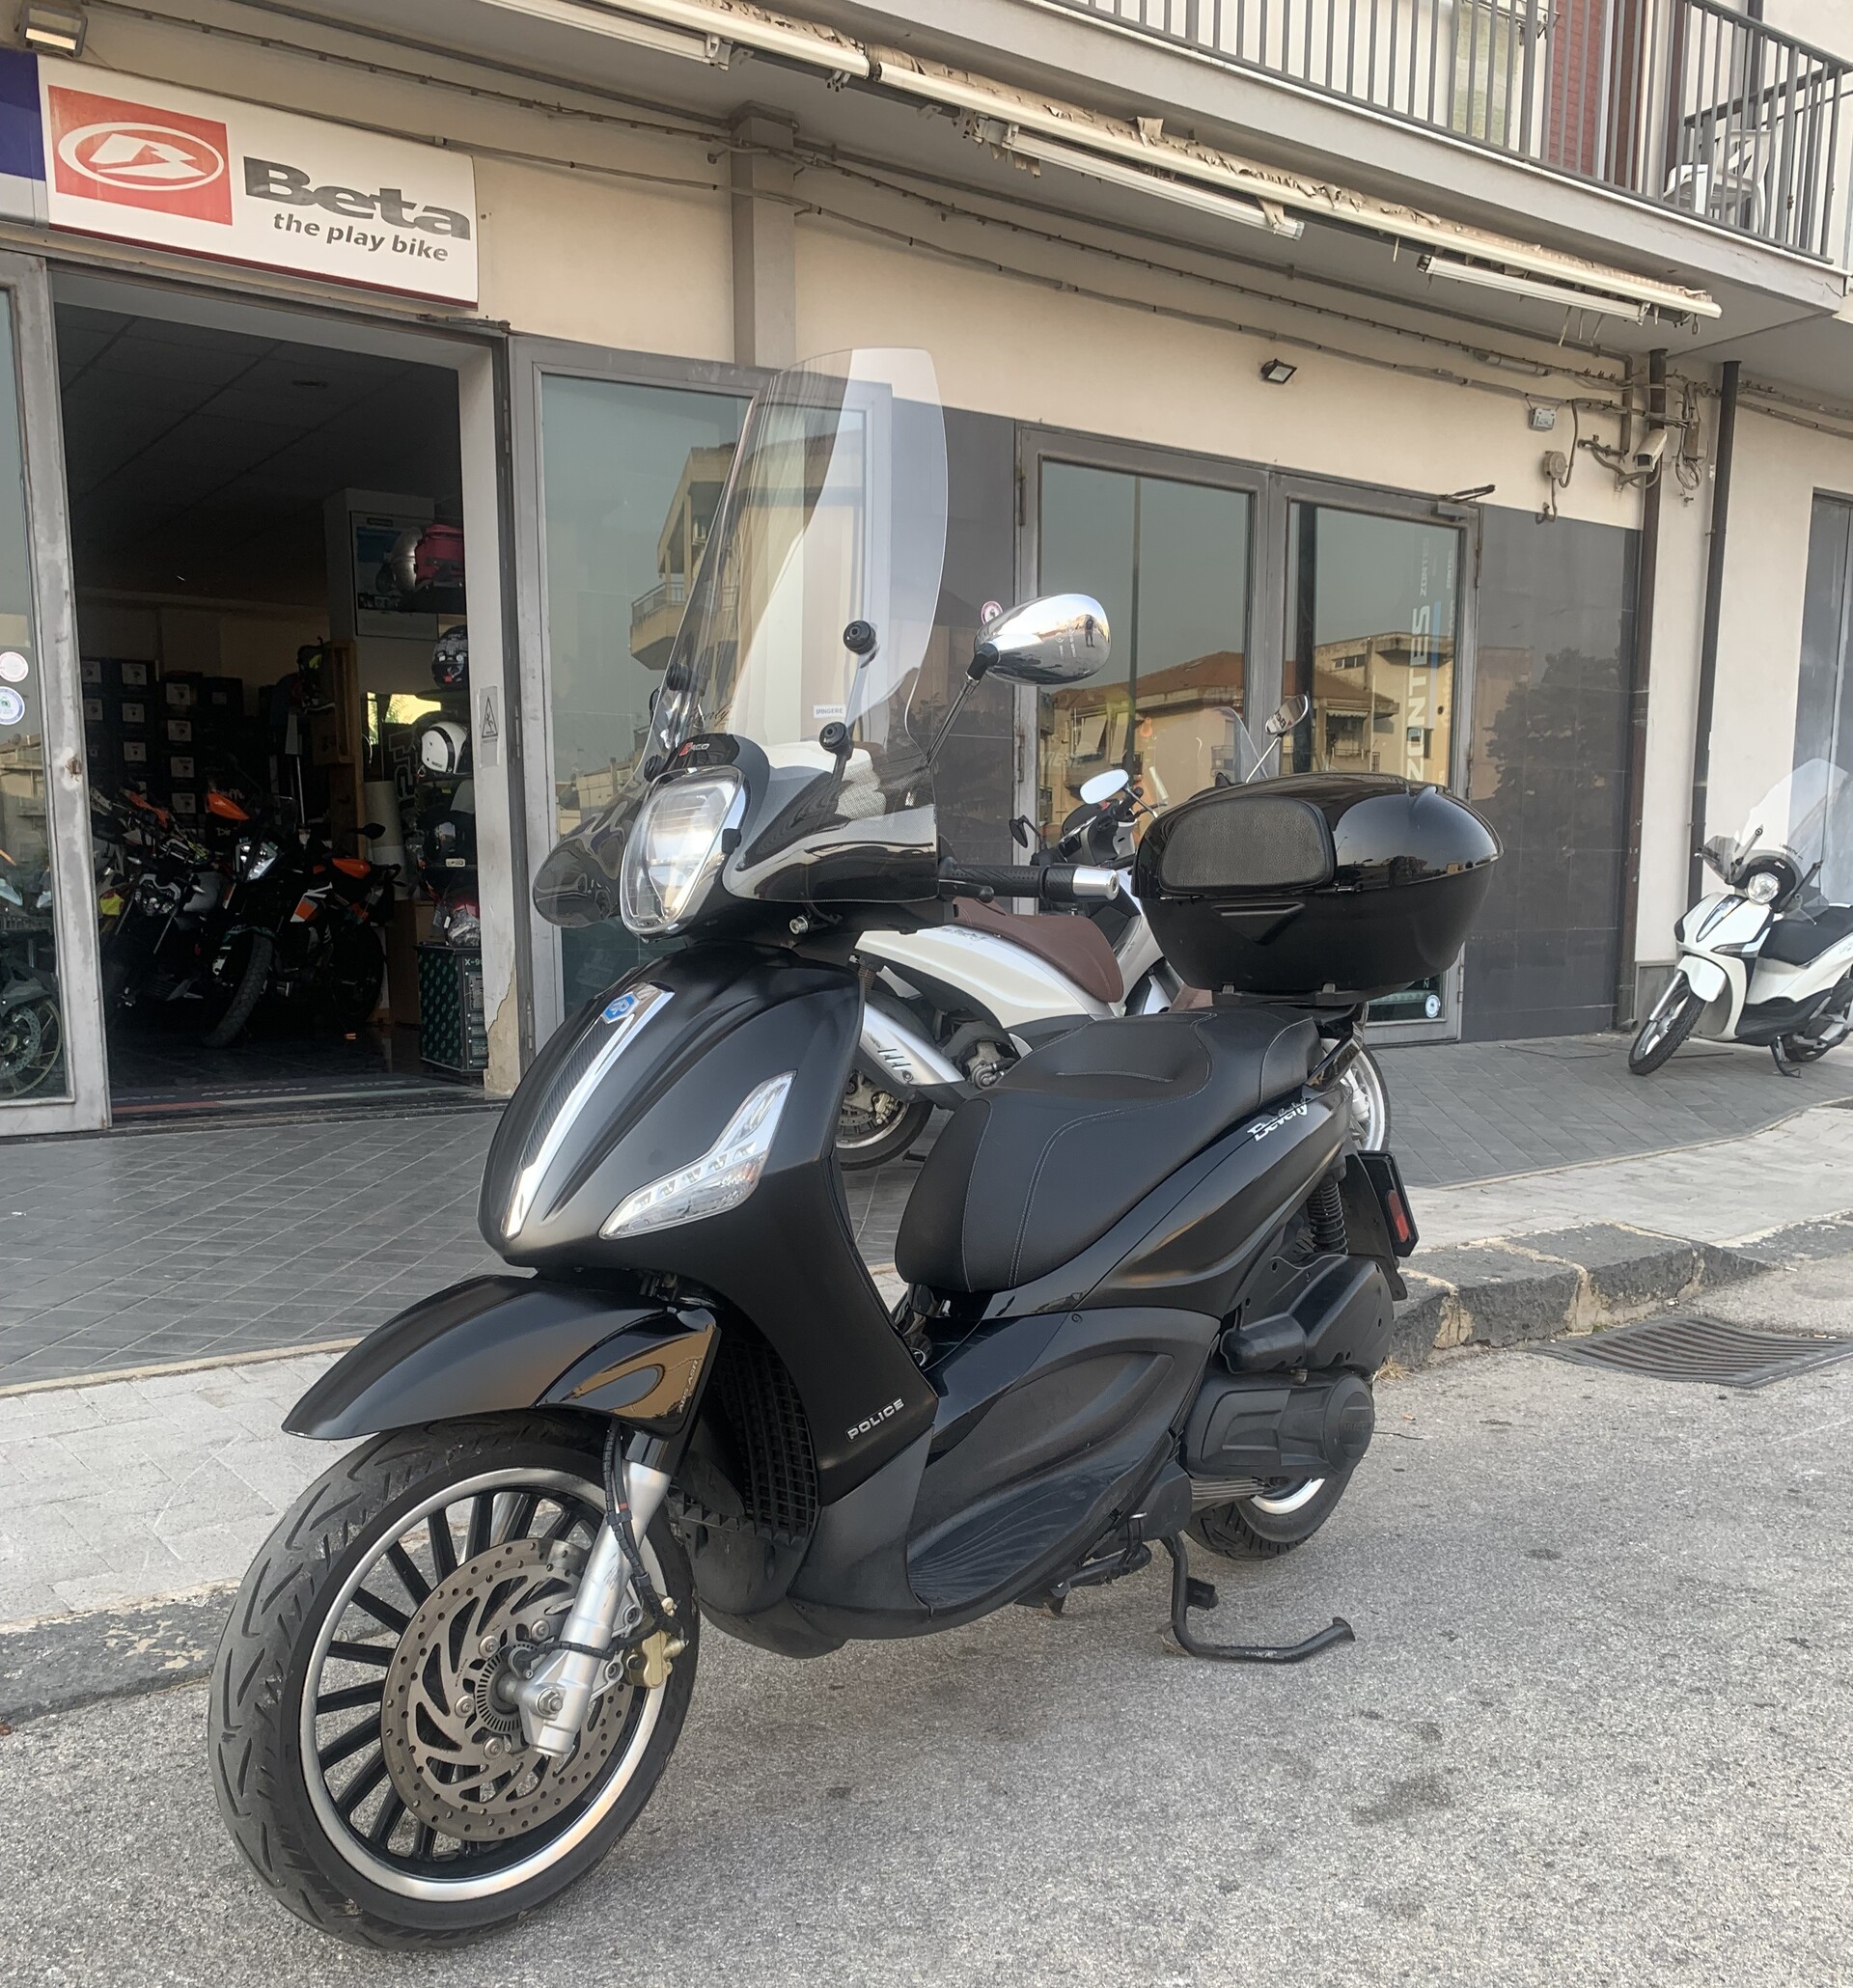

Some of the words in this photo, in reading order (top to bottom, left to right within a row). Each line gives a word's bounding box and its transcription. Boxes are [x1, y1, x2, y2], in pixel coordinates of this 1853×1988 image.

[243, 155, 471, 240] Beta
[273, 212, 320, 236] the
[326, 225, 385, 252] play
[391, 234, 449, 262] bike
[1406, 605, 1430, 782] ZONTES
[464, 957, 484, 966] X-9
[847, 1398, 904, 1440] POLICE
